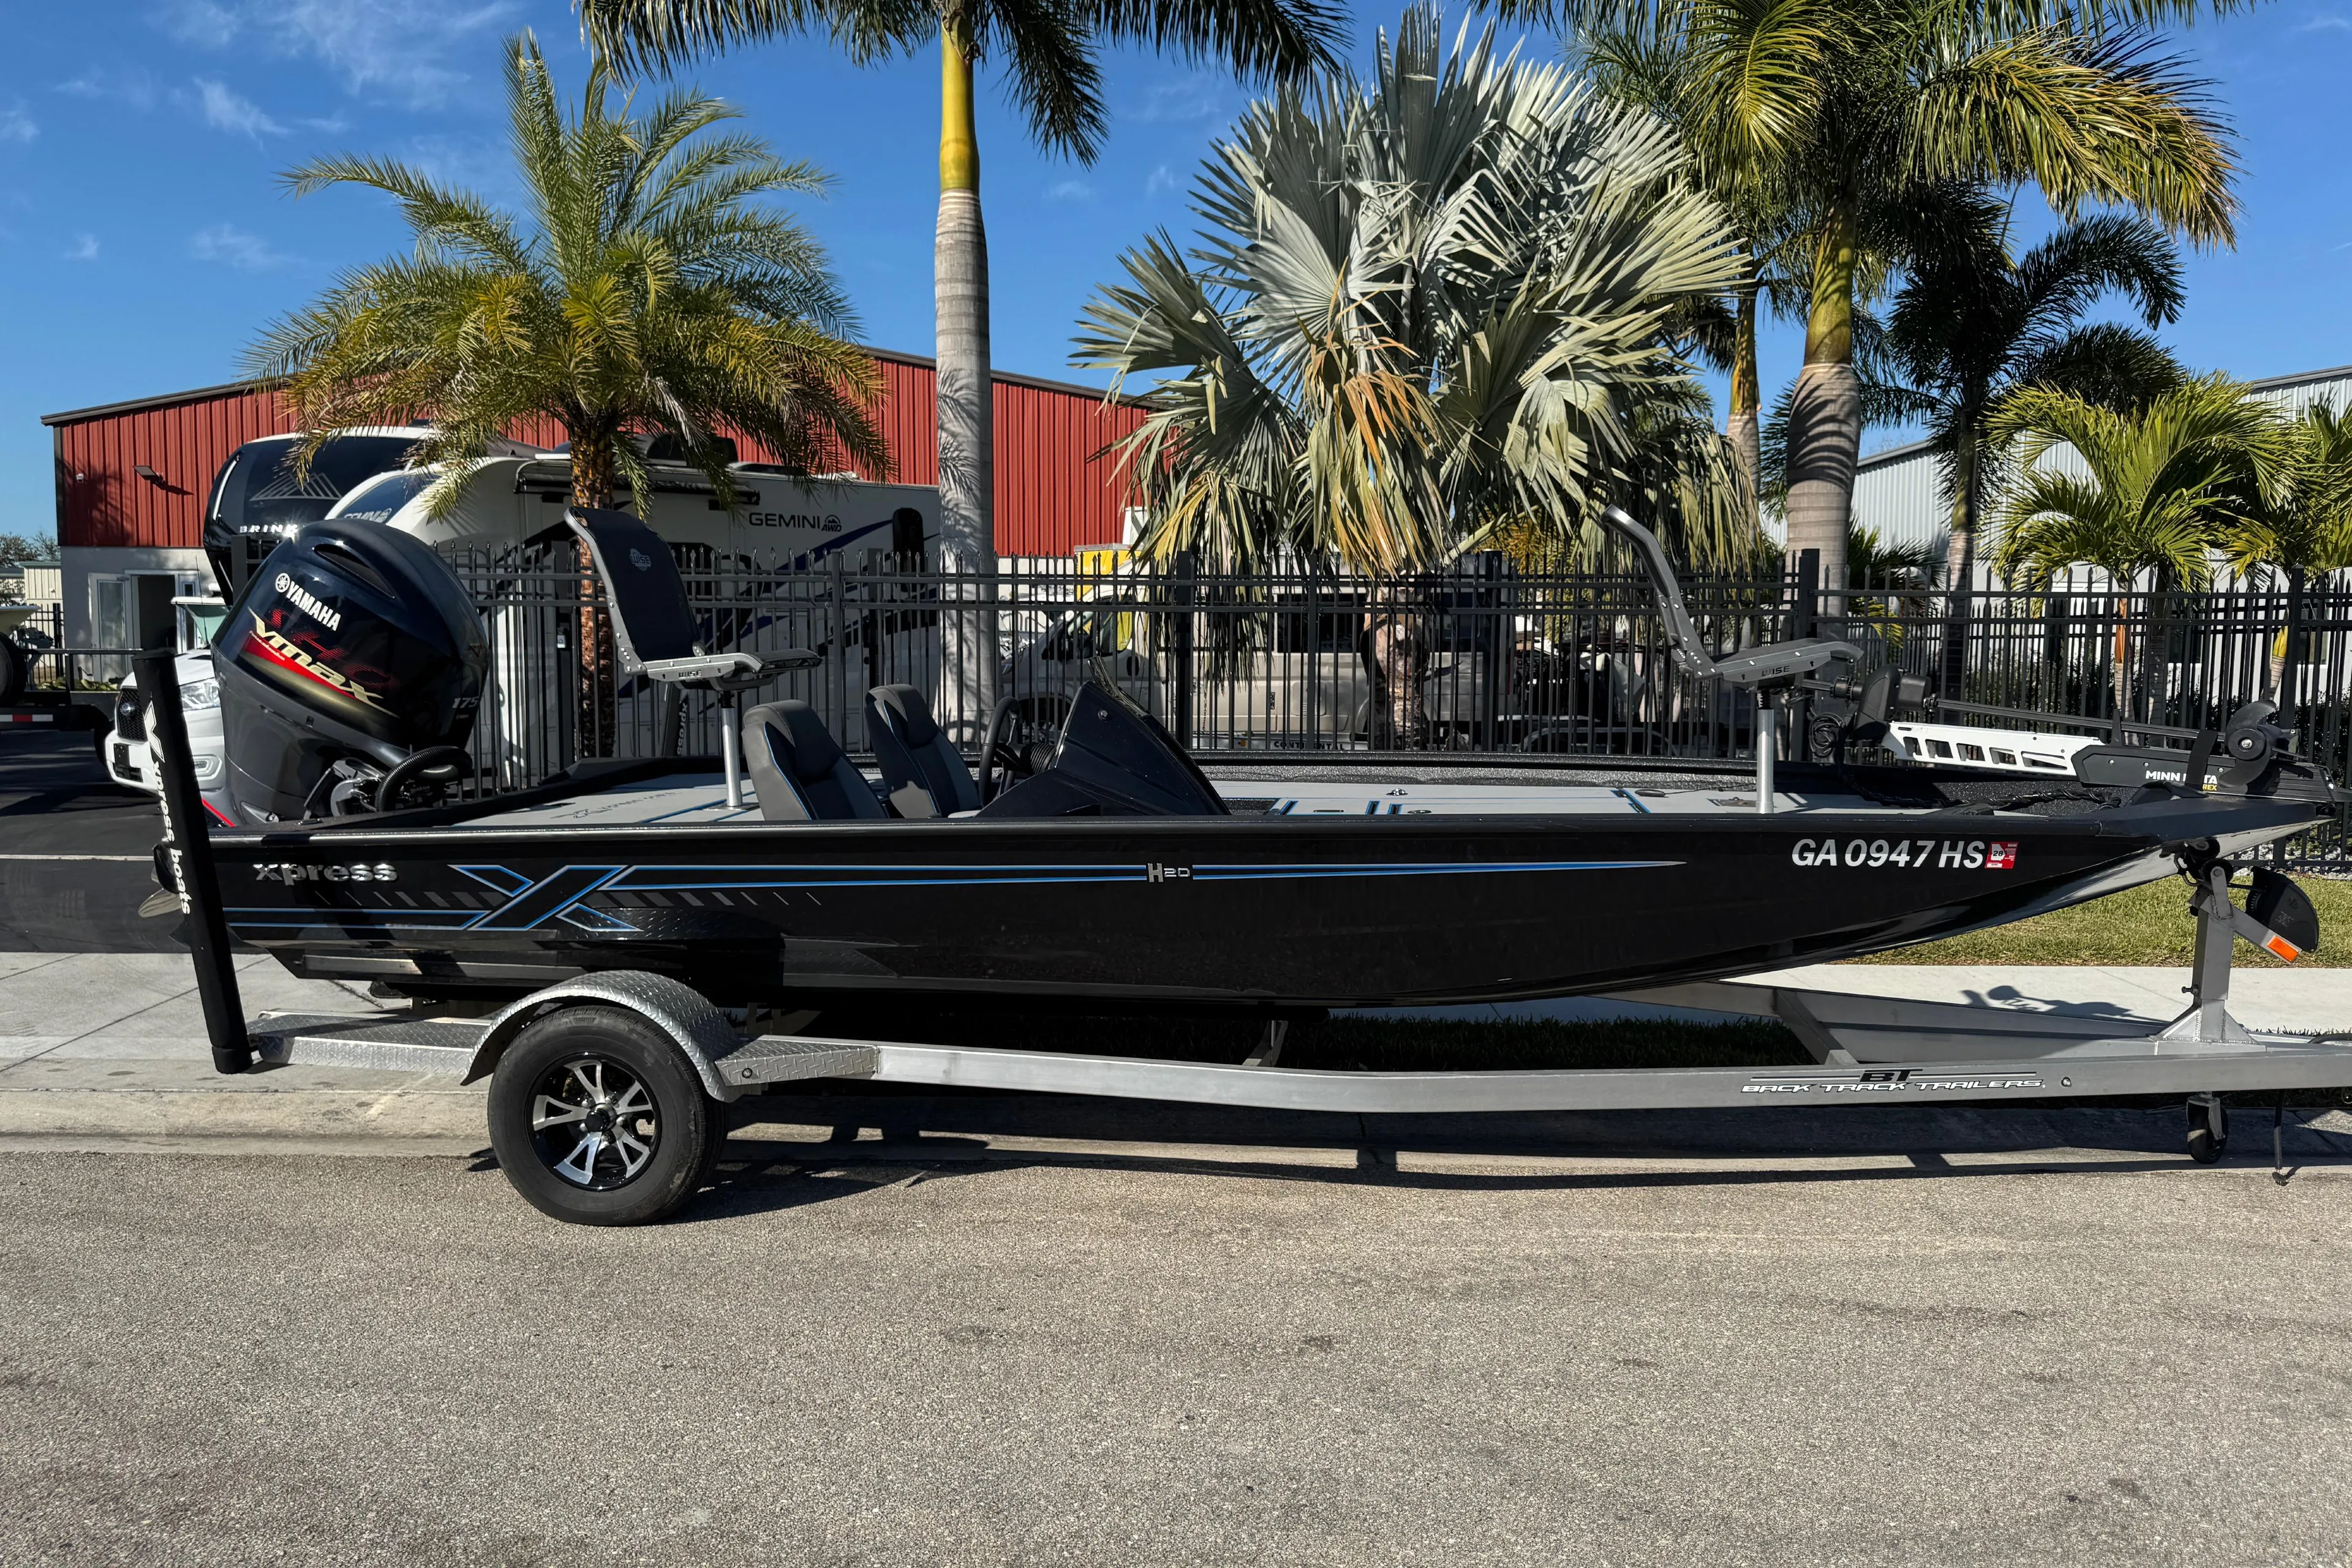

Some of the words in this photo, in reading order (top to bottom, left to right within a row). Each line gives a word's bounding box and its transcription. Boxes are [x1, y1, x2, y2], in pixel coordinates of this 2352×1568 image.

[748, 513, 821, 529] GEMINI
[239, 524, 300, 535] BRINK
[629, 552, 651, 564] WISE
[285, 581, 341, 631] YAMAHA
[679, 669, 702, 679] WISE
[1762, 665, 1790, 677] WISE
[452, 695, 479, 709] 175
[2146, 770, 2180, 782] MINN
[154, 761, 176, 842] xpress
[170, 848, 193, 915] boats
[1792, 839, 1838, 867] GA
[1845, 839, 1936, 867] 0947
[1938, 840, 1985, 869] HS
[253, 863, 398, 886] xpress
[1860, 1069, 1923, 1082] BT
[1741, 1084, 1817, 1093] BACK
[1820, 1082, 1912, 1093] TRACK
[1915, 1079, 2043, 1090] TRAILERS
